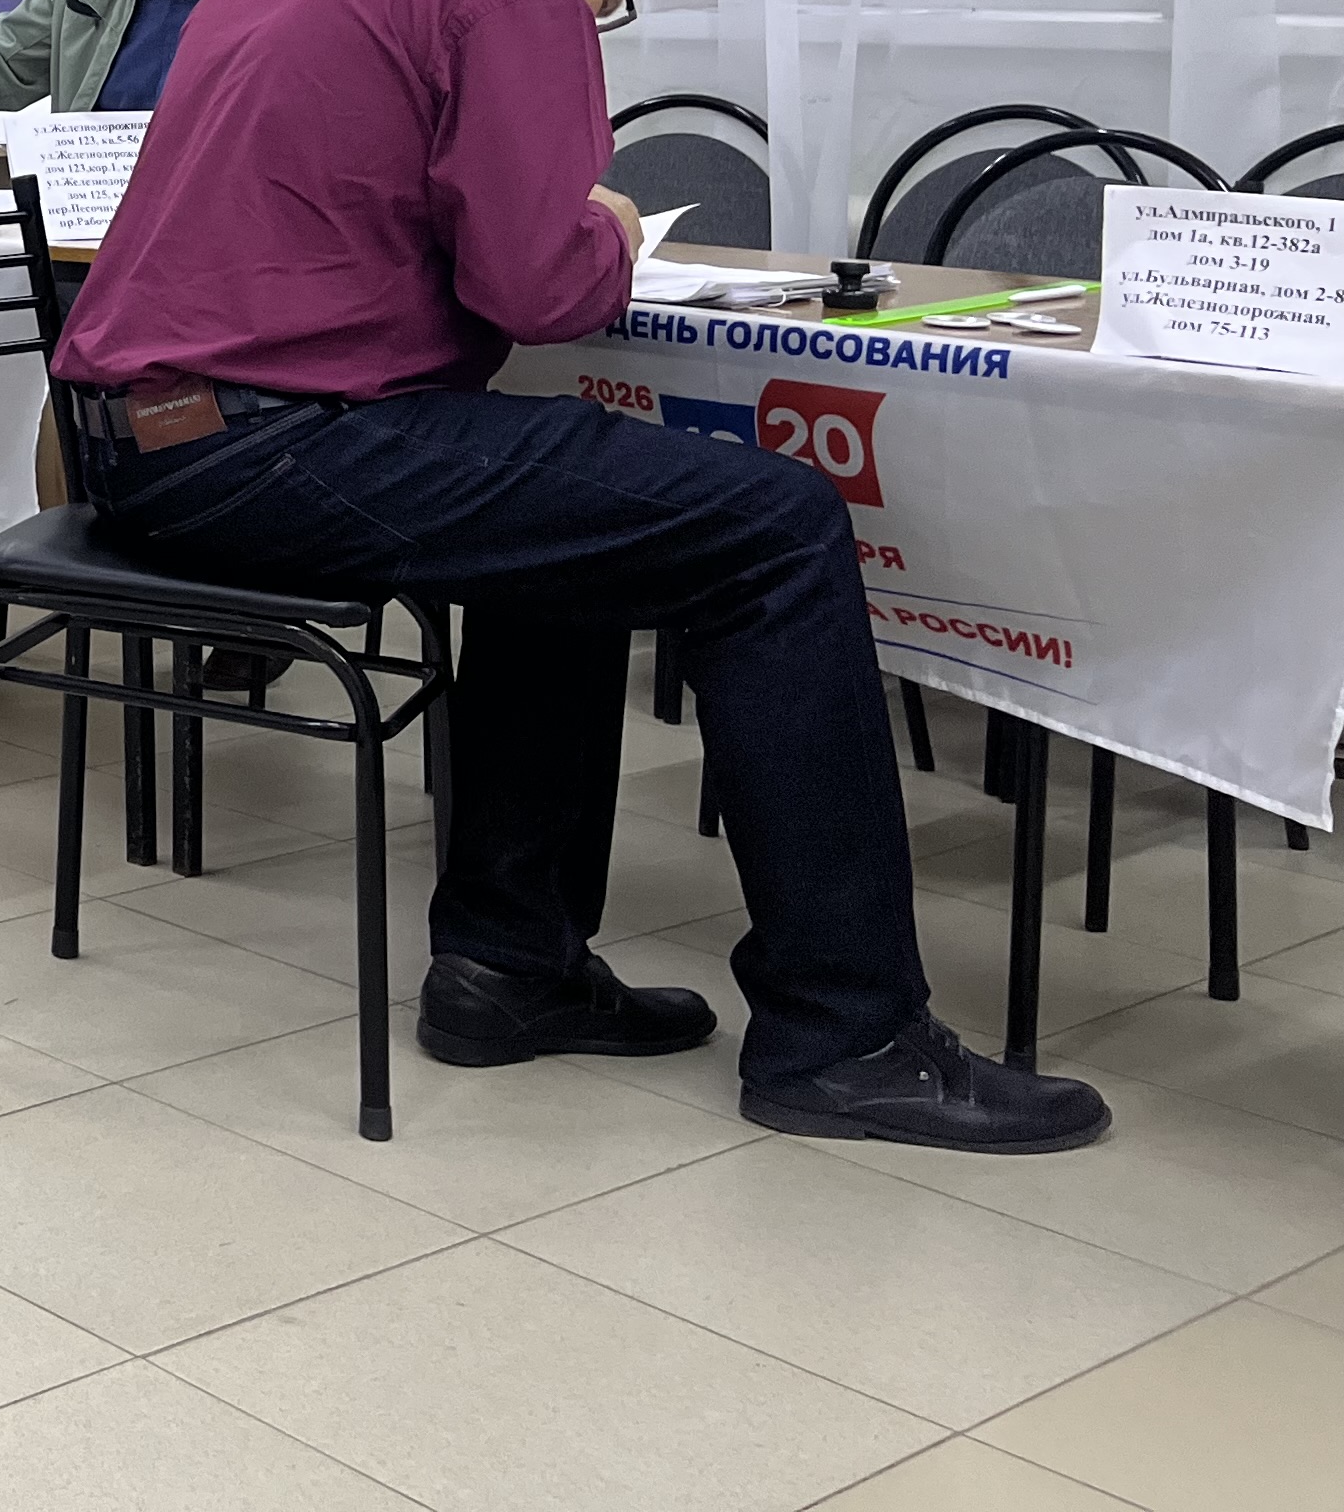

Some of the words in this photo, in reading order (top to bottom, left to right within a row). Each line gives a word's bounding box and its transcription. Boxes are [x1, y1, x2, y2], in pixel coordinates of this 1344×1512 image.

[55, 138, 75, 146] дом
[78, 136, 99, 146] 123,
[102, 135, 139, 144] кв.5-56
[45, 165, 65, 173] дом
[91, 190, 111, 199] 125,
[1135, 205, 1321, 233] ул.Адмиральского,
[1147, 230, 1182, 241] дом
[1190, 230, 1213, 245] 1а,
[1220, 235, 1321, 254] кв.12-382а
[1187, 254, 1224, 267] дом
[1229, 255, 1270, 272] 3-19
[1119, 270, 1265, 296] ул.Бульварная,
[1270, 286, 1309, 299] дом
[1122, 291, 1331, 327] ул.Железнодорожная,
[1164, 320, 1202, 332] дом
[1210, 321, 1270, 340] 75-113
[707, 319, 1012, 379] ГОЛОСОВАНИЯ
[577, 374, 654, 411] 2026
[765, 407, 865, 478] 20
[891, 607, 1073, 669] РОССИИ!
